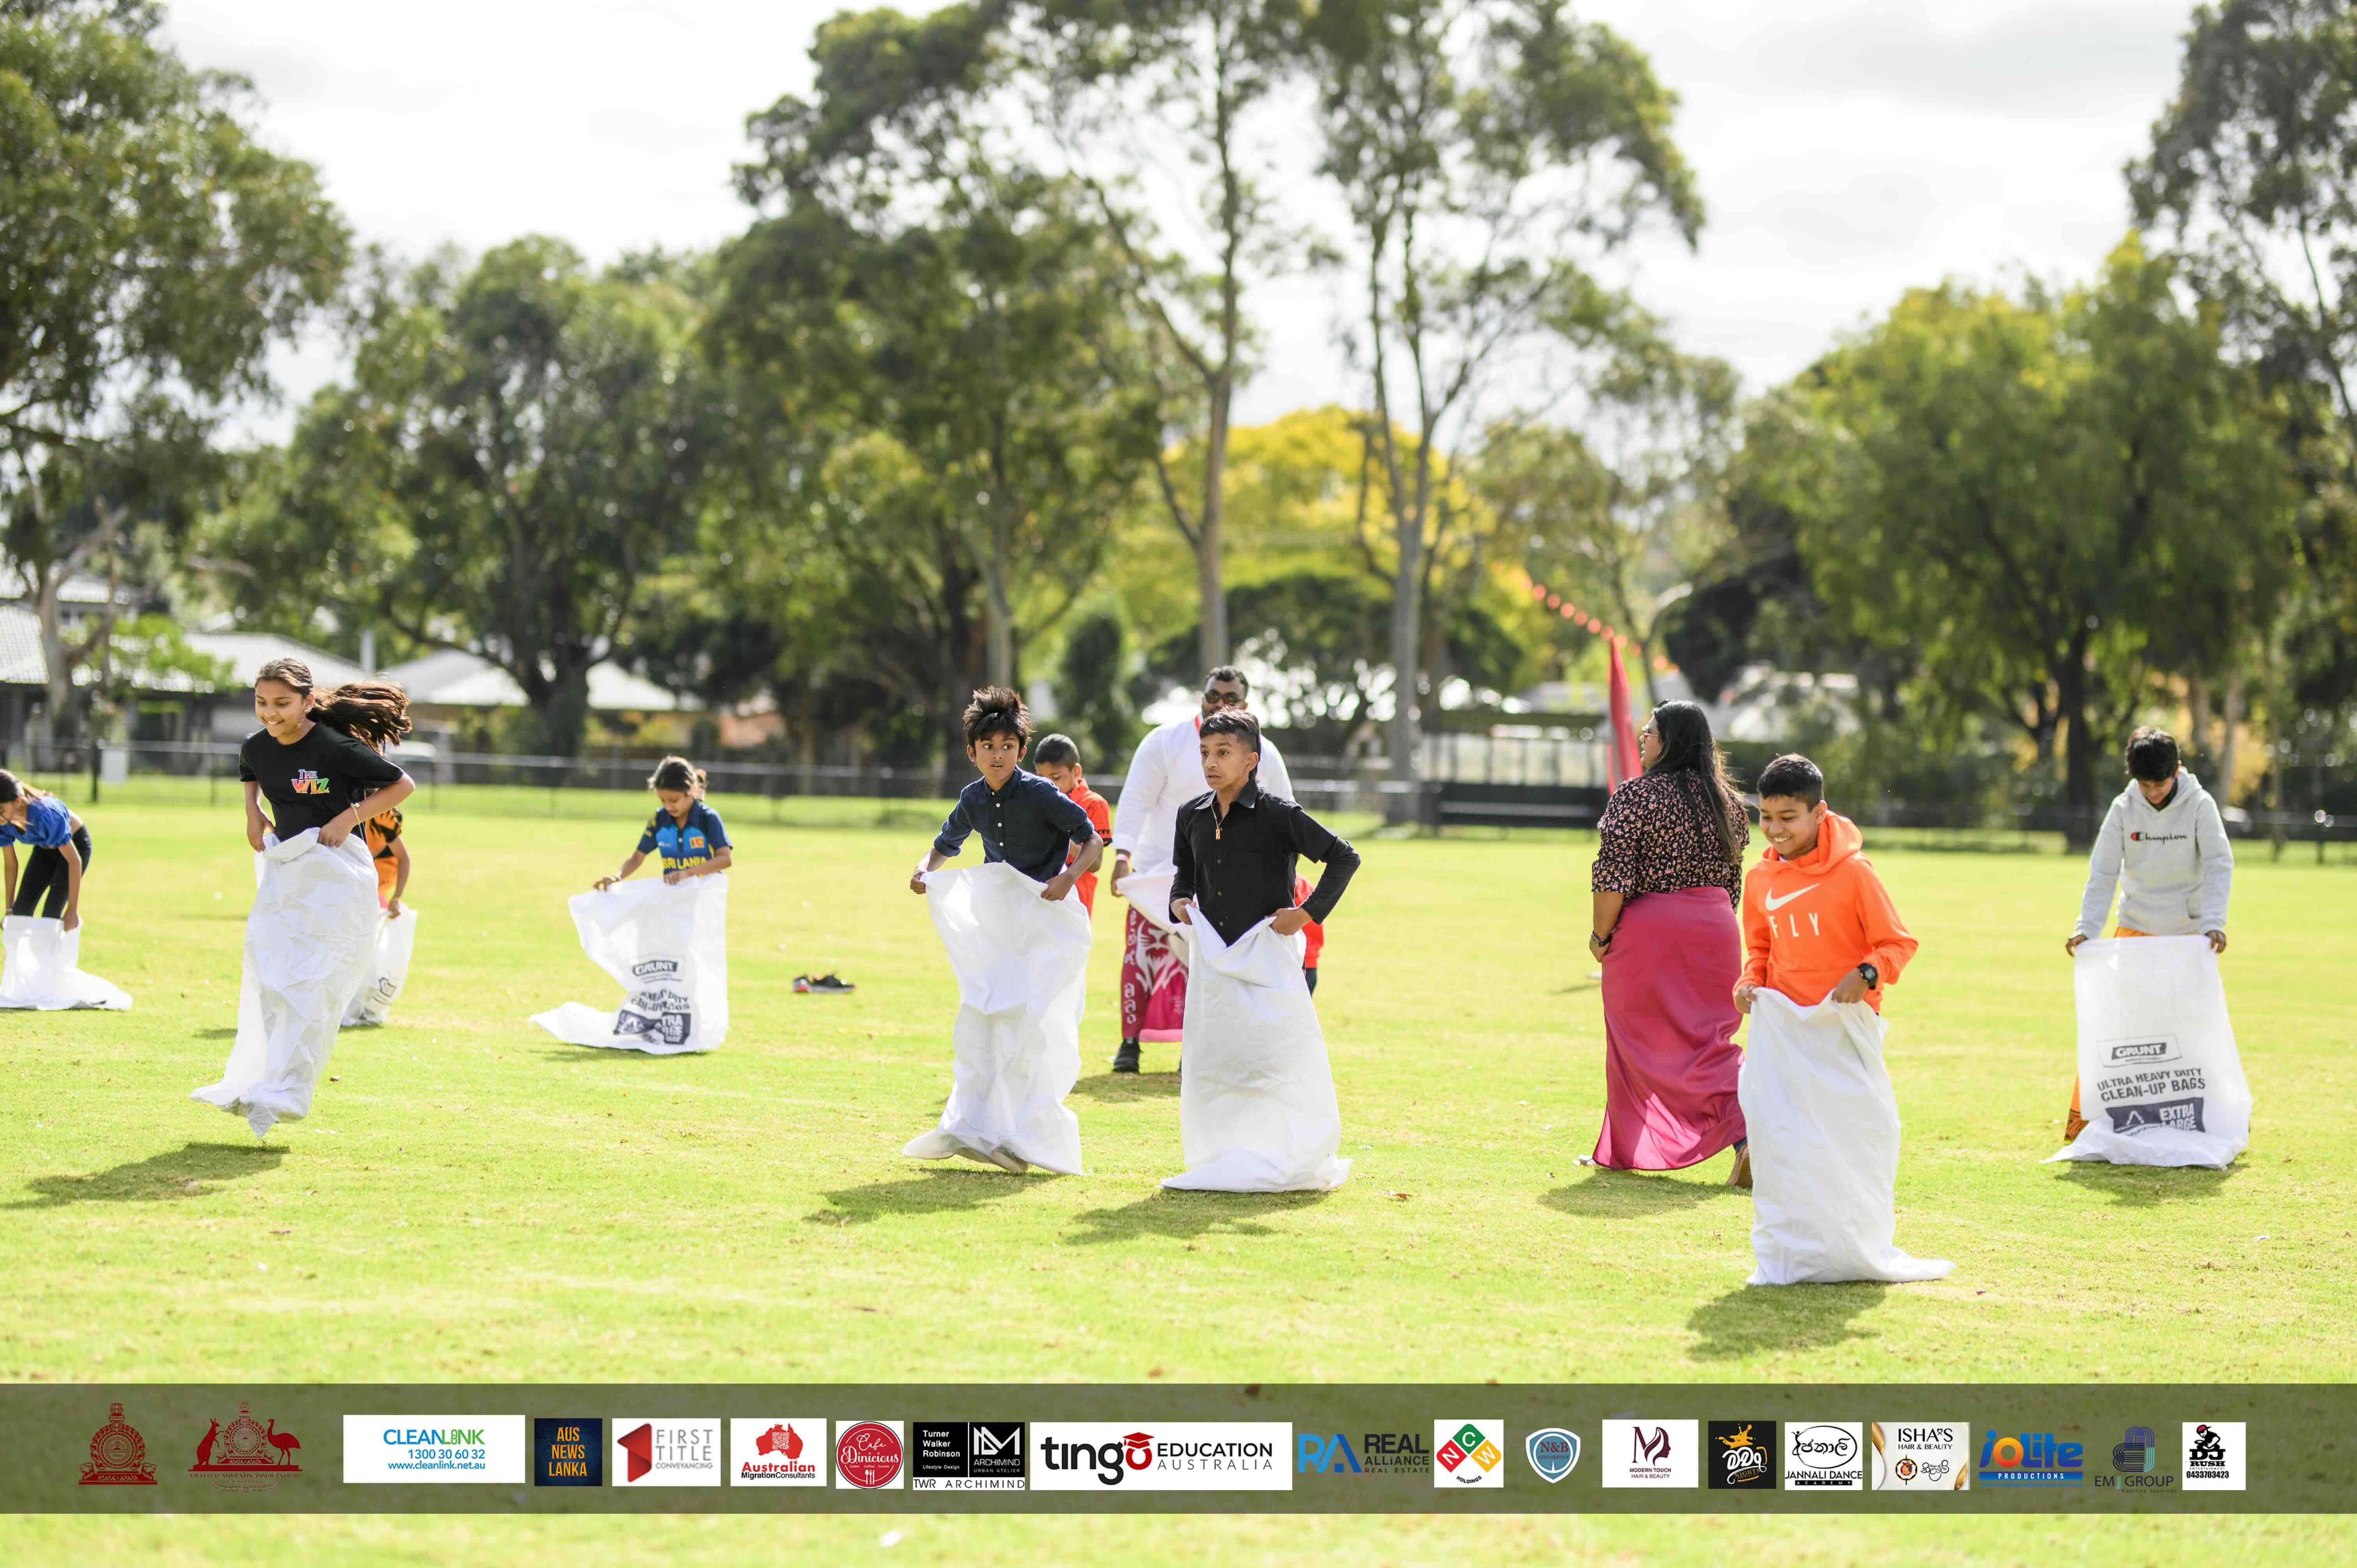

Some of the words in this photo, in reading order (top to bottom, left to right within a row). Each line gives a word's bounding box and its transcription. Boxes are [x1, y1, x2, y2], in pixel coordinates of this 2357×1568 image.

[291, 778, 329, 794] WIZ
[663, 858, 676, 869] SRI
[1769, 913, 1819, 938] FLY
[2116, 1044, 2162, 1057] GRUNT
[2097, 1077, 2133, 1091] ULTRA
[2135, 1071, 2170, 1082] HEAVY
[2174, 1068, 2201, 1077] DUTY
[2101, 1082, 2166, 1102] CLEAN-UP
[2171, 1077, 2206, 1092] BAGS
[2159, 1103, 2195, 1121] EXTRA
